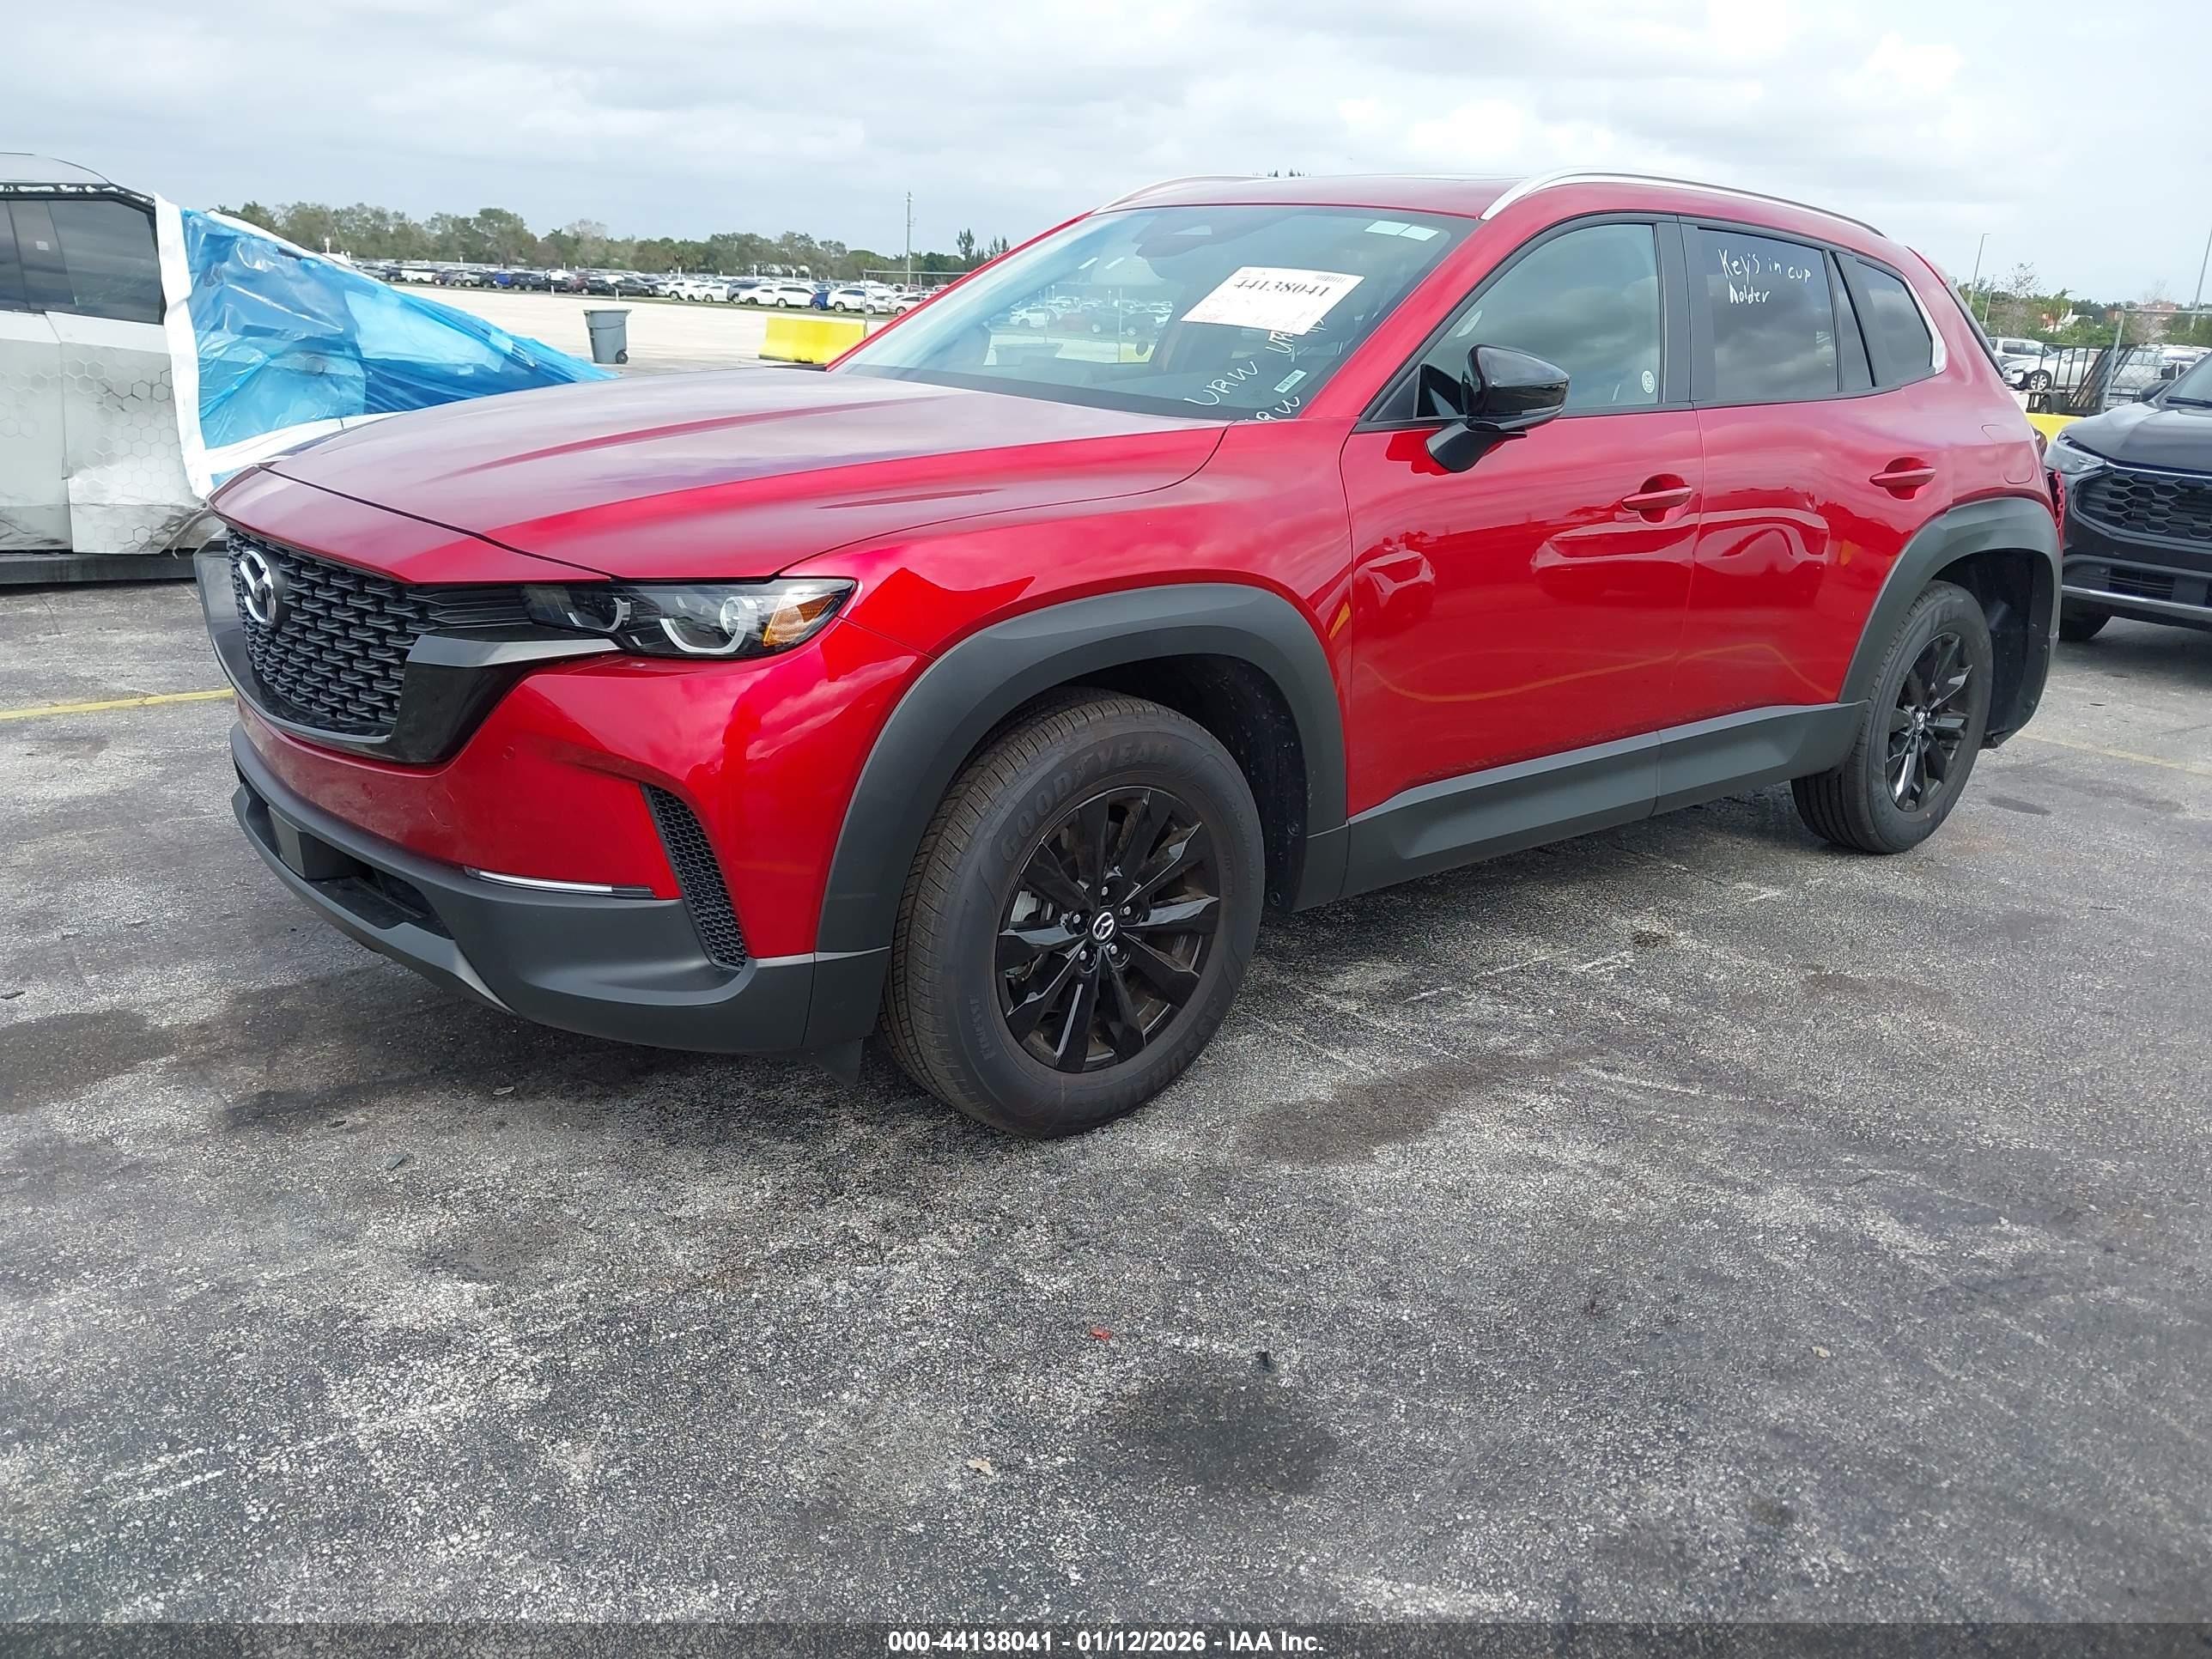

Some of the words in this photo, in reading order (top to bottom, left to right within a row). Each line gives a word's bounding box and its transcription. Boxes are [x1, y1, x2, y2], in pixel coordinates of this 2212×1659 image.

[1768, 257, 1782, 275] in
[1788, 266, 1812, 283] cup
[1235, 279, 1330, 296] 44138041
